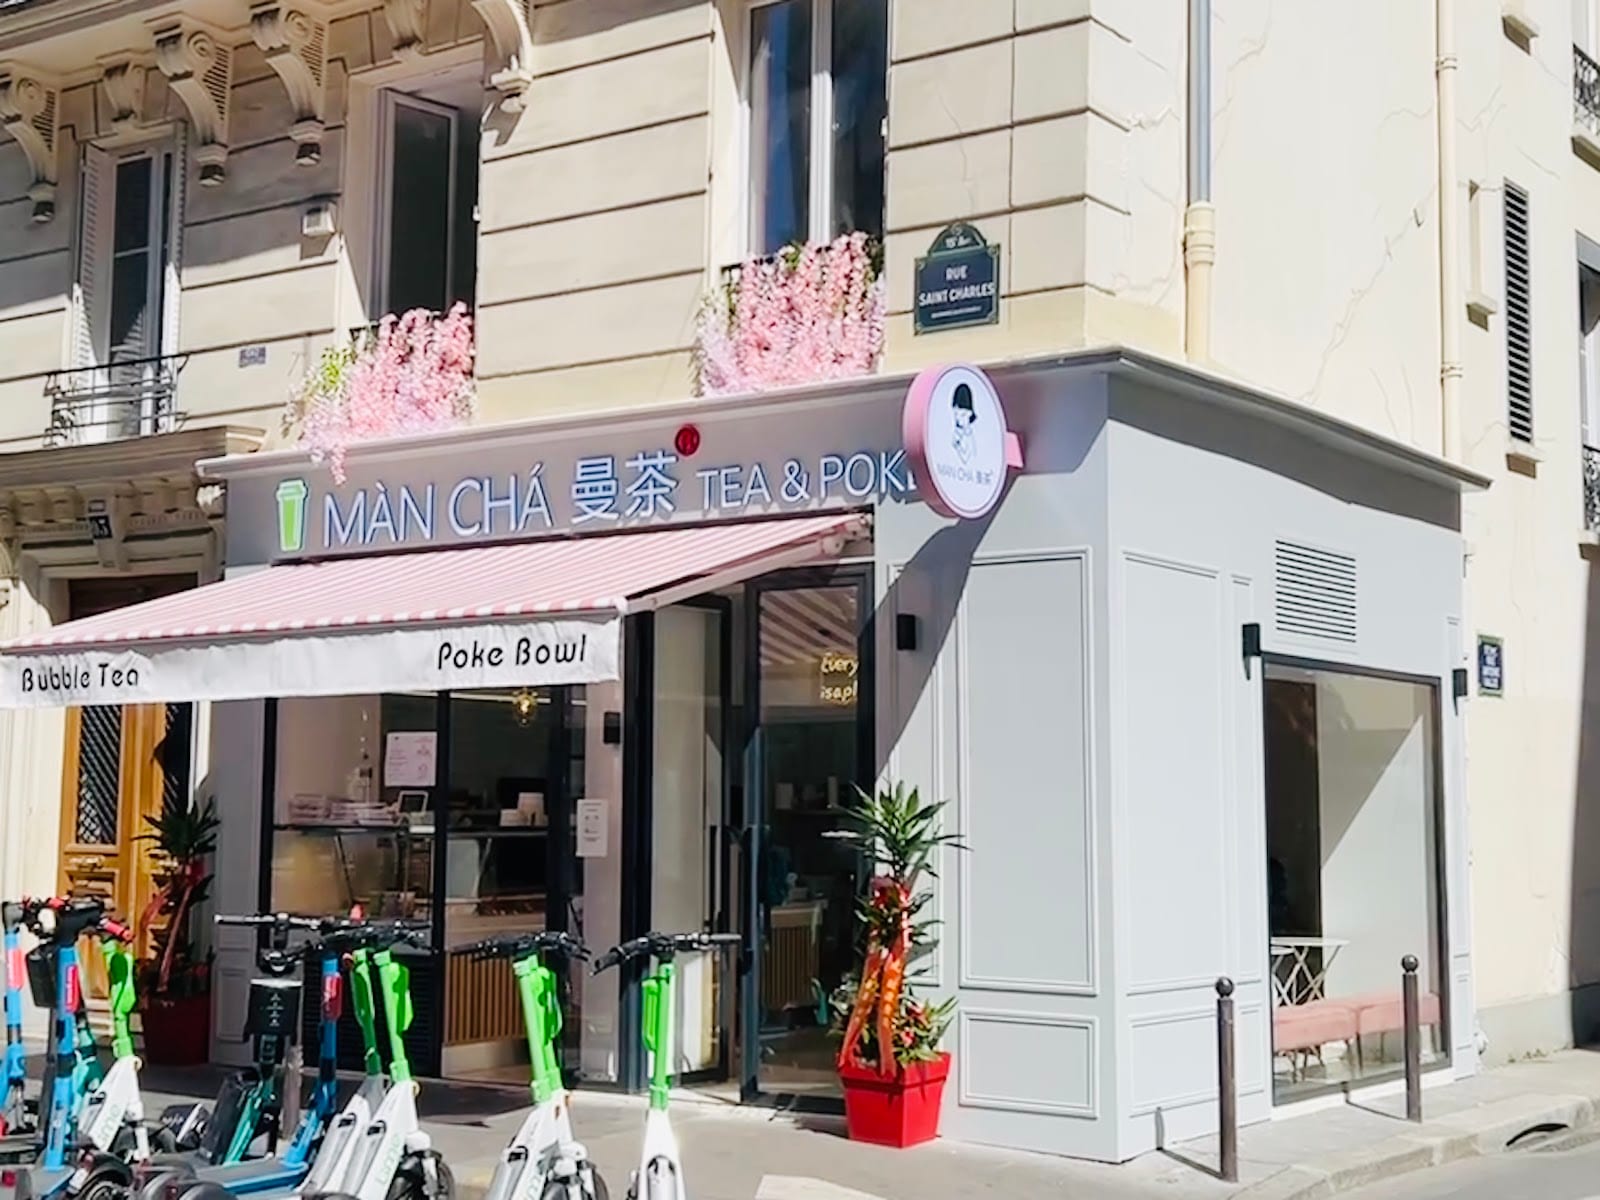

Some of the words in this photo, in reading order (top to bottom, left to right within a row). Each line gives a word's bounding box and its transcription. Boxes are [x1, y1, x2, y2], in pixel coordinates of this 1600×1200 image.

[945, 265, 968, 281] RUE
[919, 288, 949, 307] SAINT
[949, 282, 995, 302] CHARLES
[323, 481, 434, 548] MÀN
[447, 461, 553, 537] CHÁ
[570, 449, 679, 526] 曼茶
[695, 465, 771, 510] TEA
[780, 459, 811, 502] &
[438, 639, 504, 670] Poke
[515, 633, 586, 666] Bowl
[22, 664, 91, 692] Bubble
[98, 662, 139, 688] Tea
